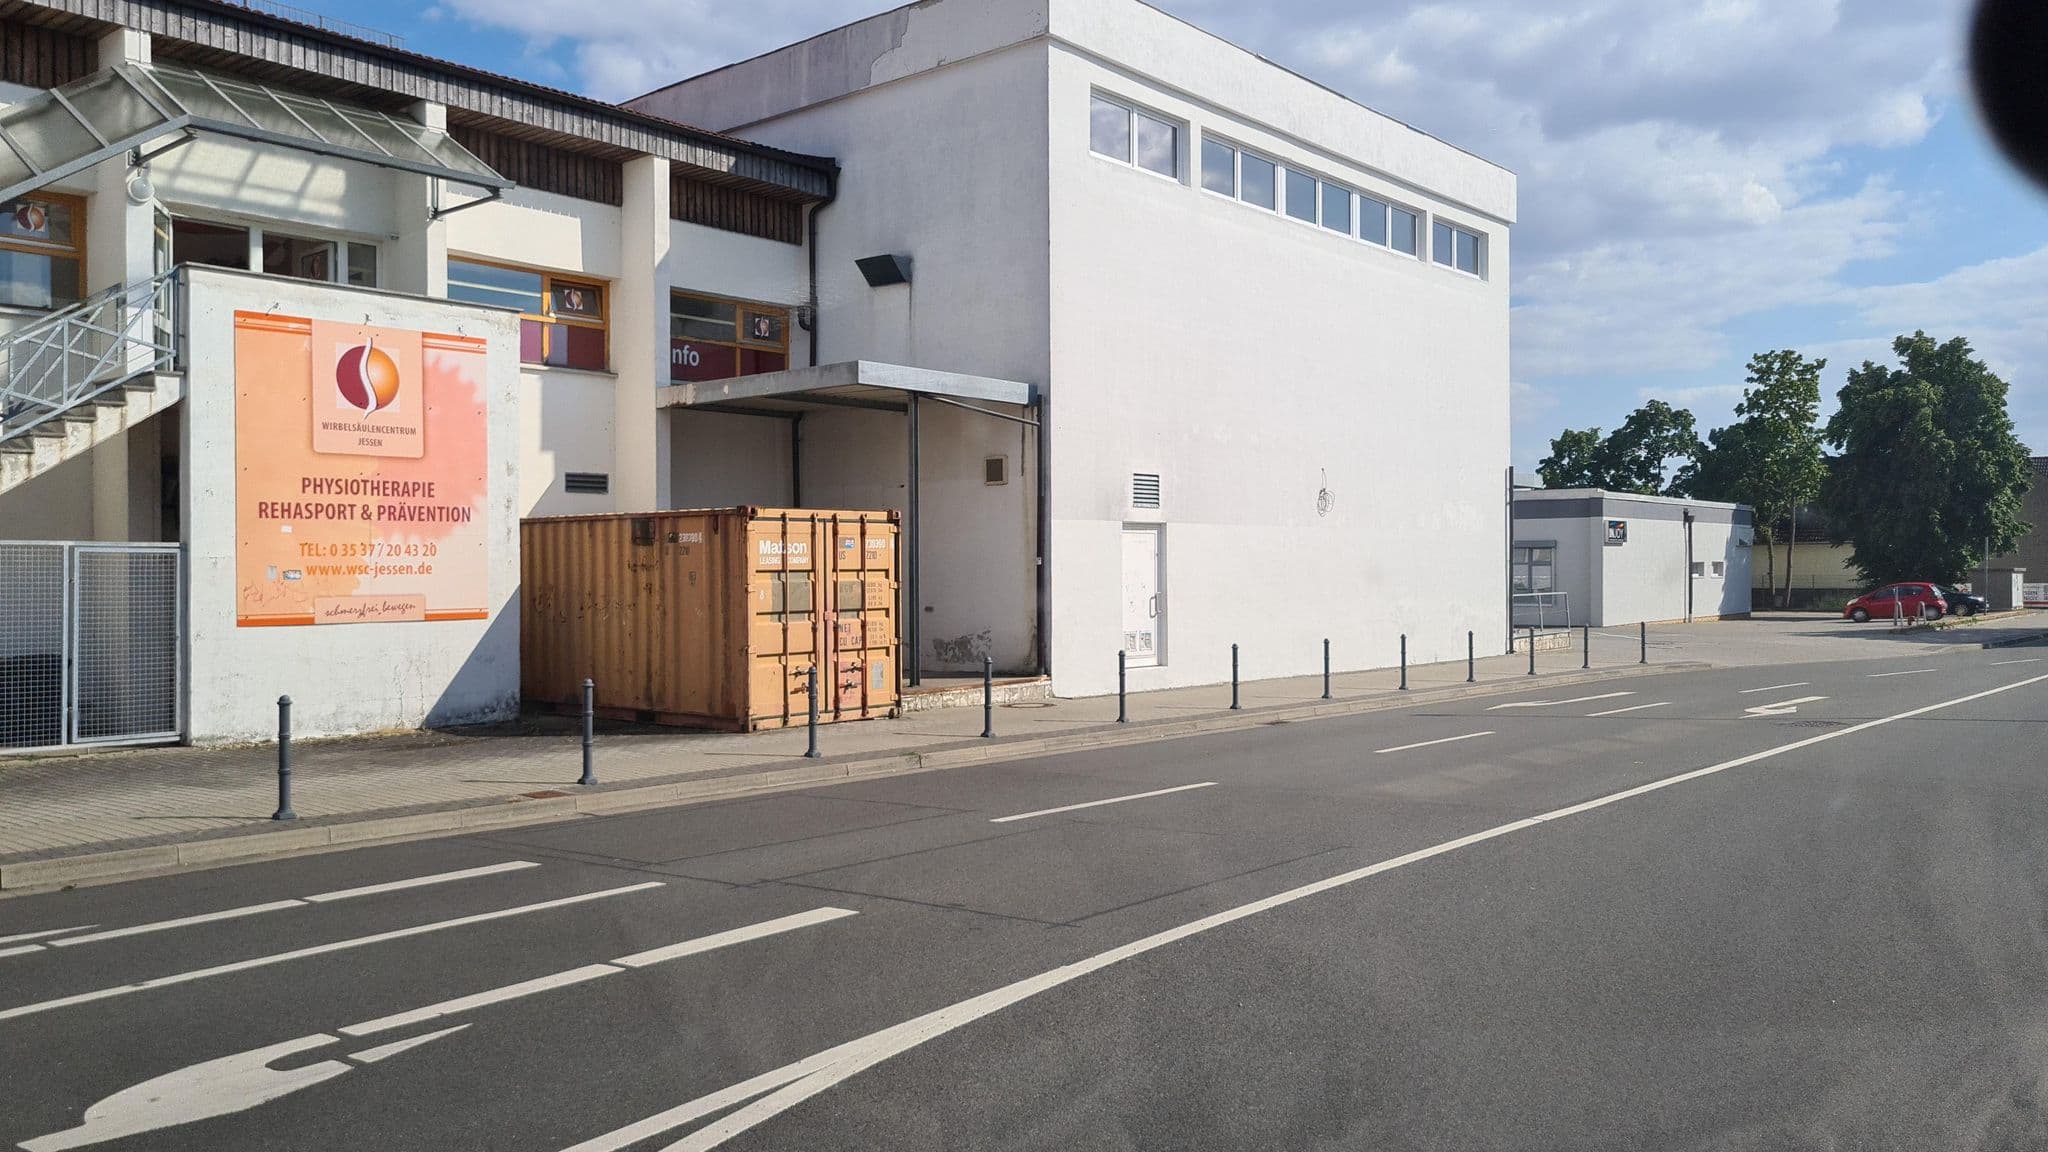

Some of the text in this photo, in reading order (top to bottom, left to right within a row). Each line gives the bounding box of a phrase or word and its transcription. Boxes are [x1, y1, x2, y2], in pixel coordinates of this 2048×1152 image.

[672, 344, 700, 367] nfo
[321, 421, 417, 435] WIRBELSÄULENCENTRUM
[358, 437, 383, 447] JESSEN
[301, 477, 435, 498] PHYSIOTHERAPIE
[258, 501, 472, 522] REHASPORT & PRÄVENTION
[299, 543, 327, 557] TEL:
[330, 544, 338, 556] 0
[342, 544, 357, 556] 35
[360, 544, 375, 557] 37
[387, 544, 401, 557] 20
[404, 544, 419, 557] 43
[422, 544, 437, 557] 20
[759, 540, 807, 554] Matson
[306, 562, 433, 578] www.wsc-jessen.de
[838, 623, 851, 633] NET
